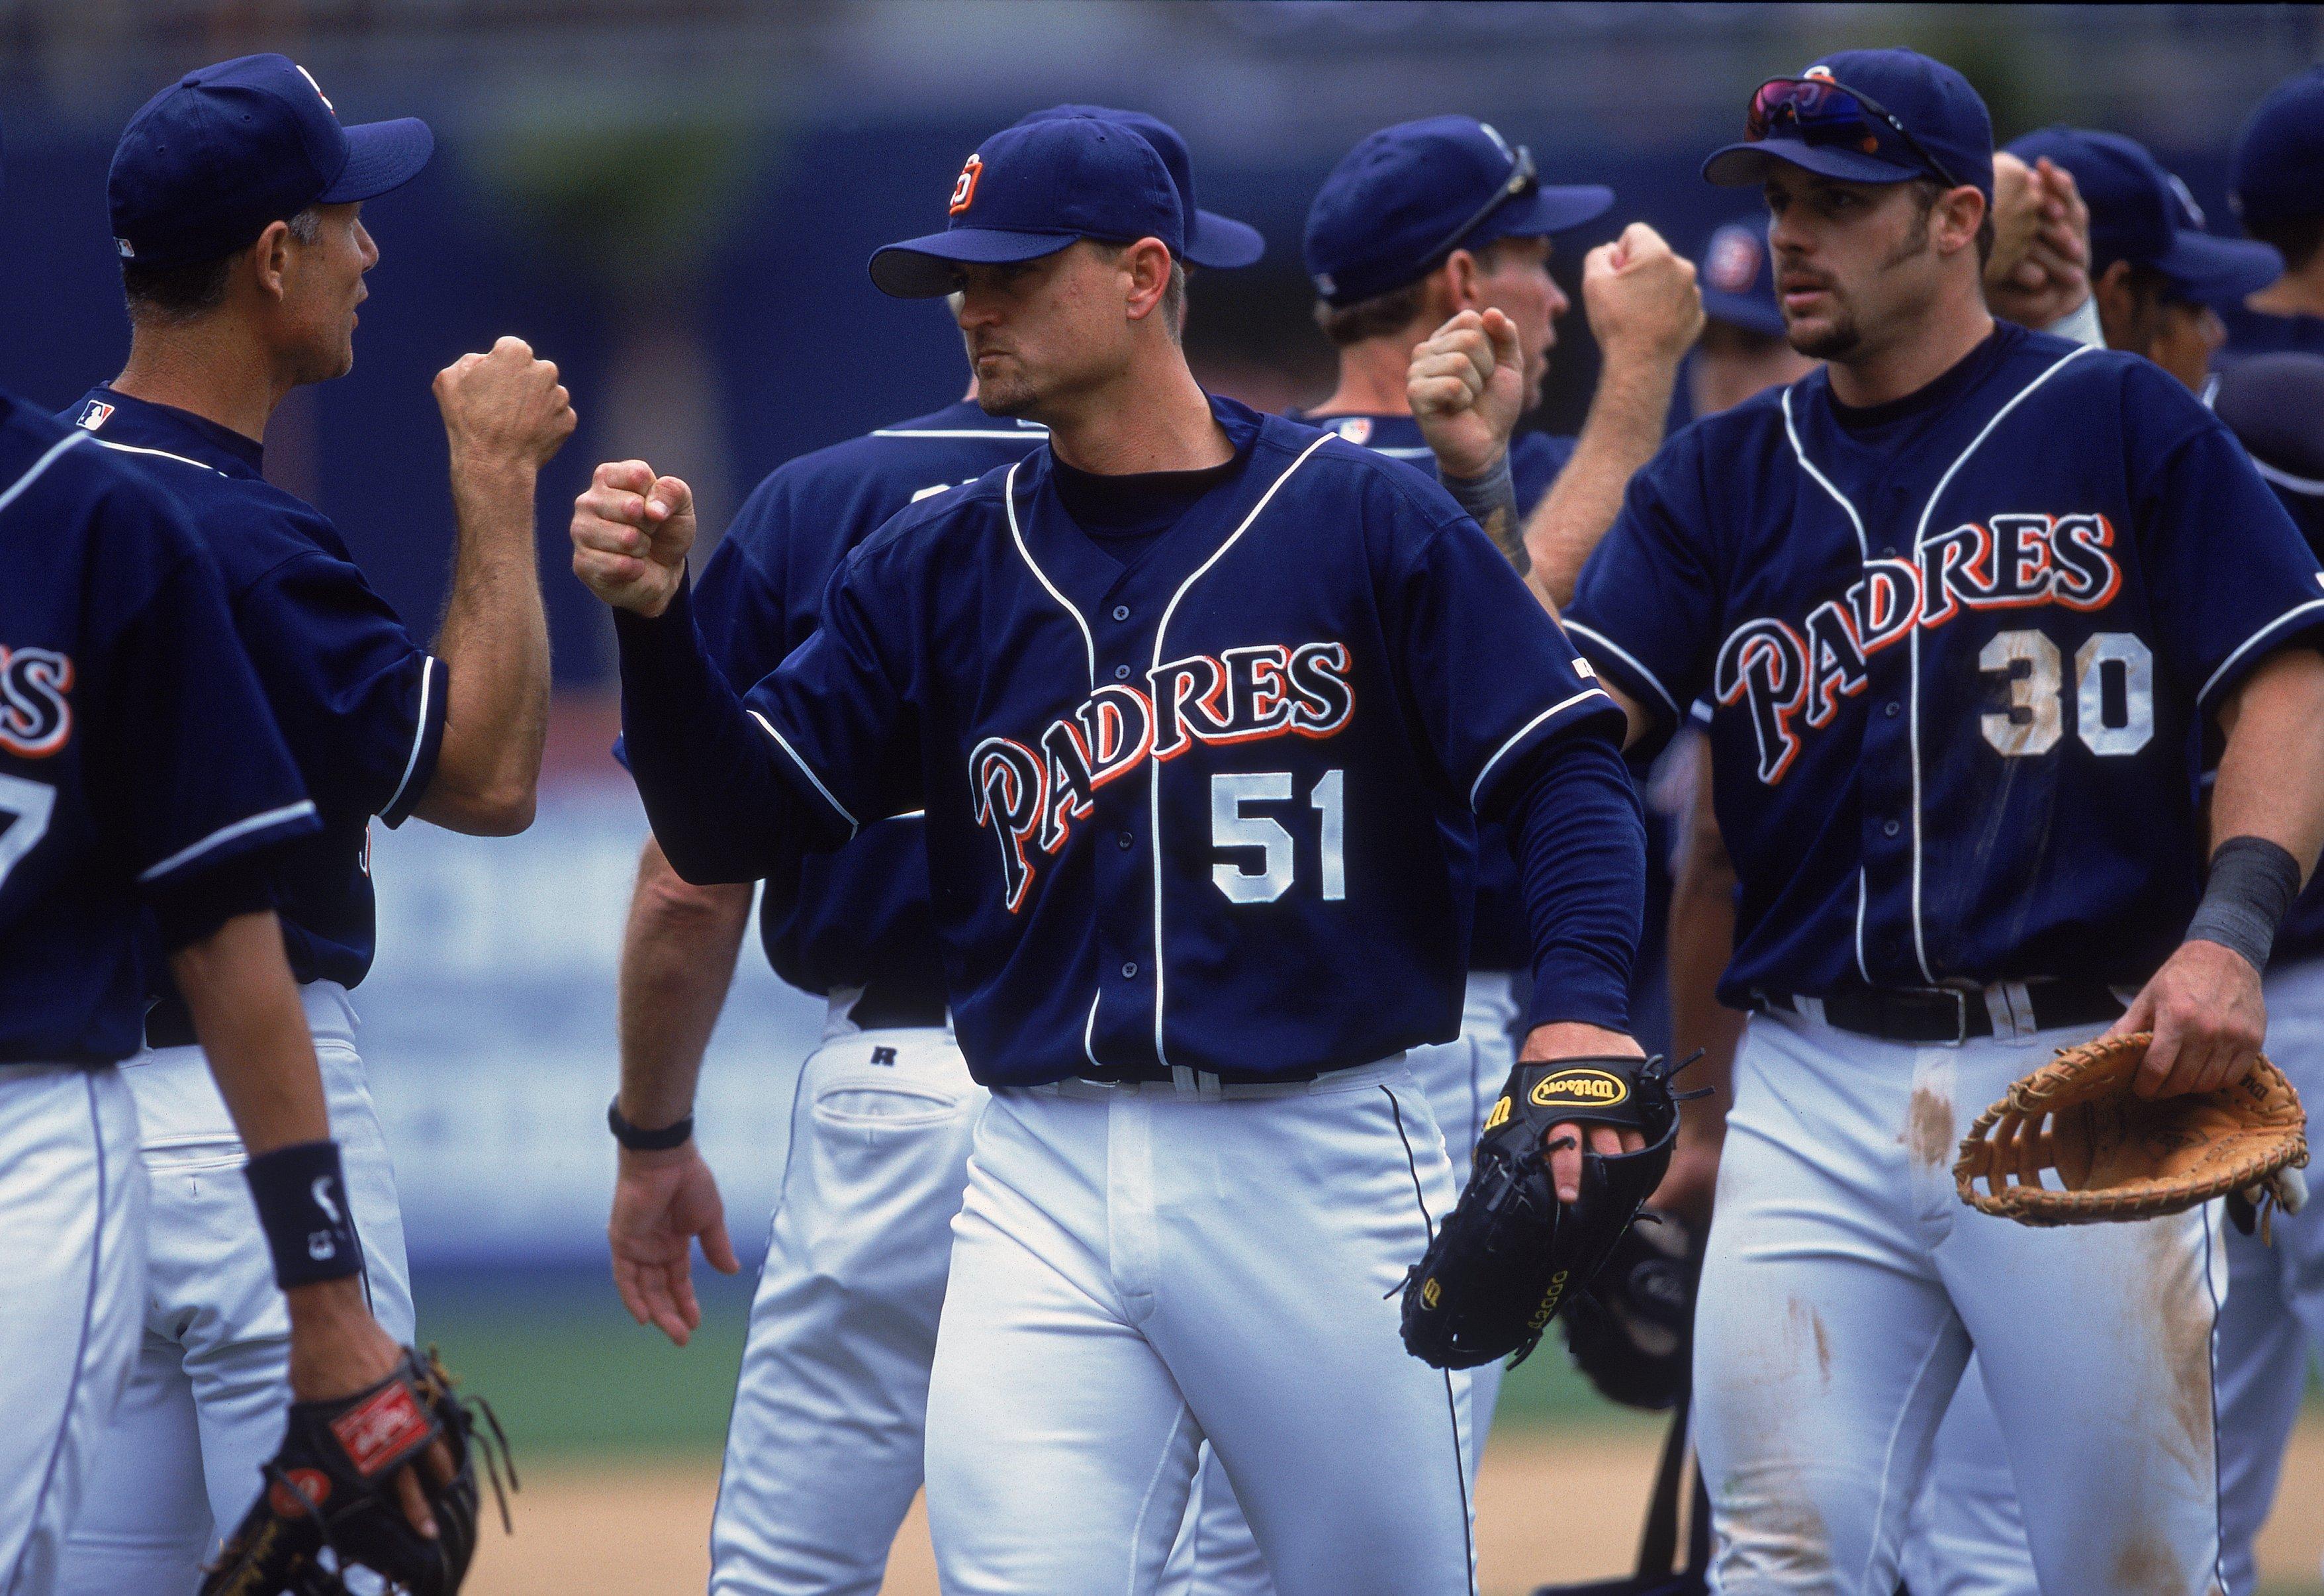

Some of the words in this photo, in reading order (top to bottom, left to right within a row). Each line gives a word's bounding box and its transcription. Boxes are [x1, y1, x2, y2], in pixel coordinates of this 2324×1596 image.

[1714, 513, 2122, 785] PADRES
[1978, 629, 2155, 757] 30
[968, 642, 1357, 914] PADRES
[1211, 769, 1346, 904] 51
[871, 1046, 897, 1066] R
[1541, 1079, 1615, 1098] Wilson
